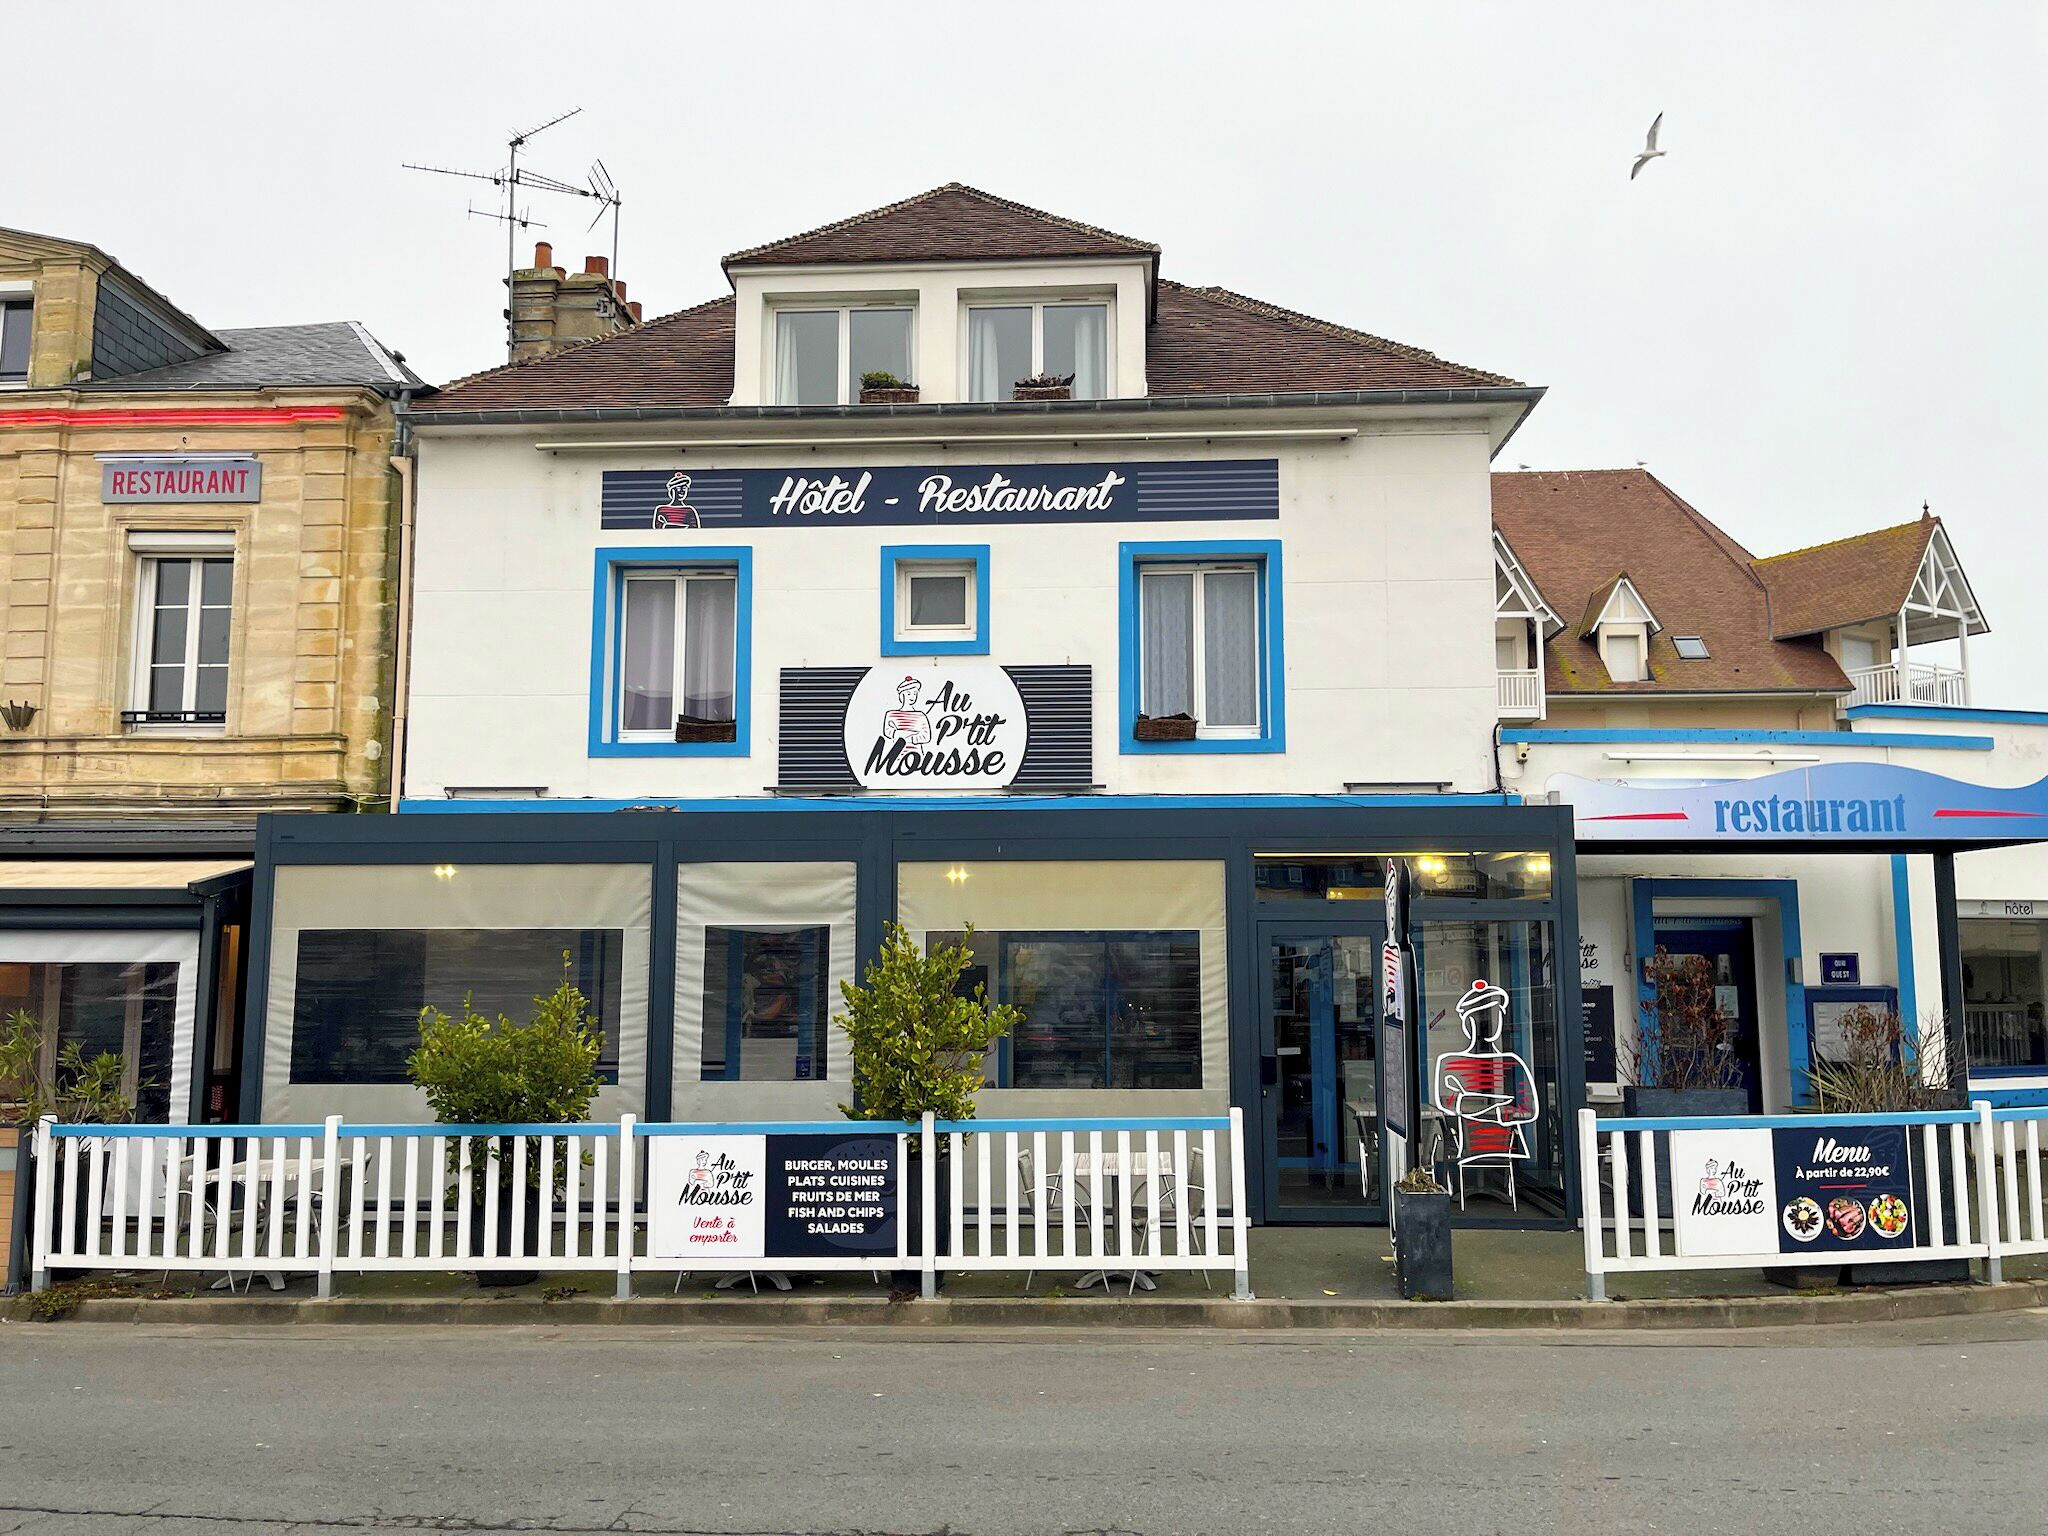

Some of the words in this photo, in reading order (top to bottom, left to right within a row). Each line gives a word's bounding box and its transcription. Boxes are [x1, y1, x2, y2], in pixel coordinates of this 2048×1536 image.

[112, 470, 249, 495] RESTAURANT
[769, 471, 872, 514] Hôtel
[918, 470, 1125, 513] Restaurant
[925, 680, 972, 714] Au
[935, 713, 1006, 746] P'tit
[864, 735, 1006, 776] Mousse
[1714, 794, 1907, 834] restaurant
[2005, 901, 2034, 915] hôtel
[1812, 1136, 1871, 1164] Menu
[711, 1152, 735, 1171] Au
[784, 1159, 835, 1172] BURGER,
[838, 1159, 888, 1170] MOULES
[1720, 1160, 1745, 1181] Au
[716, 1170, 753, 1189] P'tit
[787, 1175, 825, 1187] PLATS
[829, 1175, 885, 1186] CUISINES
[1795, 1166, 1804, 1178] À
[1806, 1166, 1838, 1180] partir
[1839, 1166, 1853, 1177] de
[1854, 1165, 1890, 1178] 22,90€
[678, 1183, 753, 1206] Mousse
[791, 1191, 834, 1202] FRUITS
[835, 1191, 852, 1202] DE
[854, 1191, 880, 1202] MER
[1727, 1178, 1764, 1198] P'tit
[788, 1207, 815, 1218] FISH
[817, 1207, 845, 1218] AND
[847, 1207, 884, 1218] CHIPS
[1691, 1193, 1765, 1216] Mousse
[693, 1215, 724, 1229] Vente
[727, 1217, 735, 1229] à
[807, 1223, 865, 1234] SALADES
[689, 1230, 738, 1246] emporter
